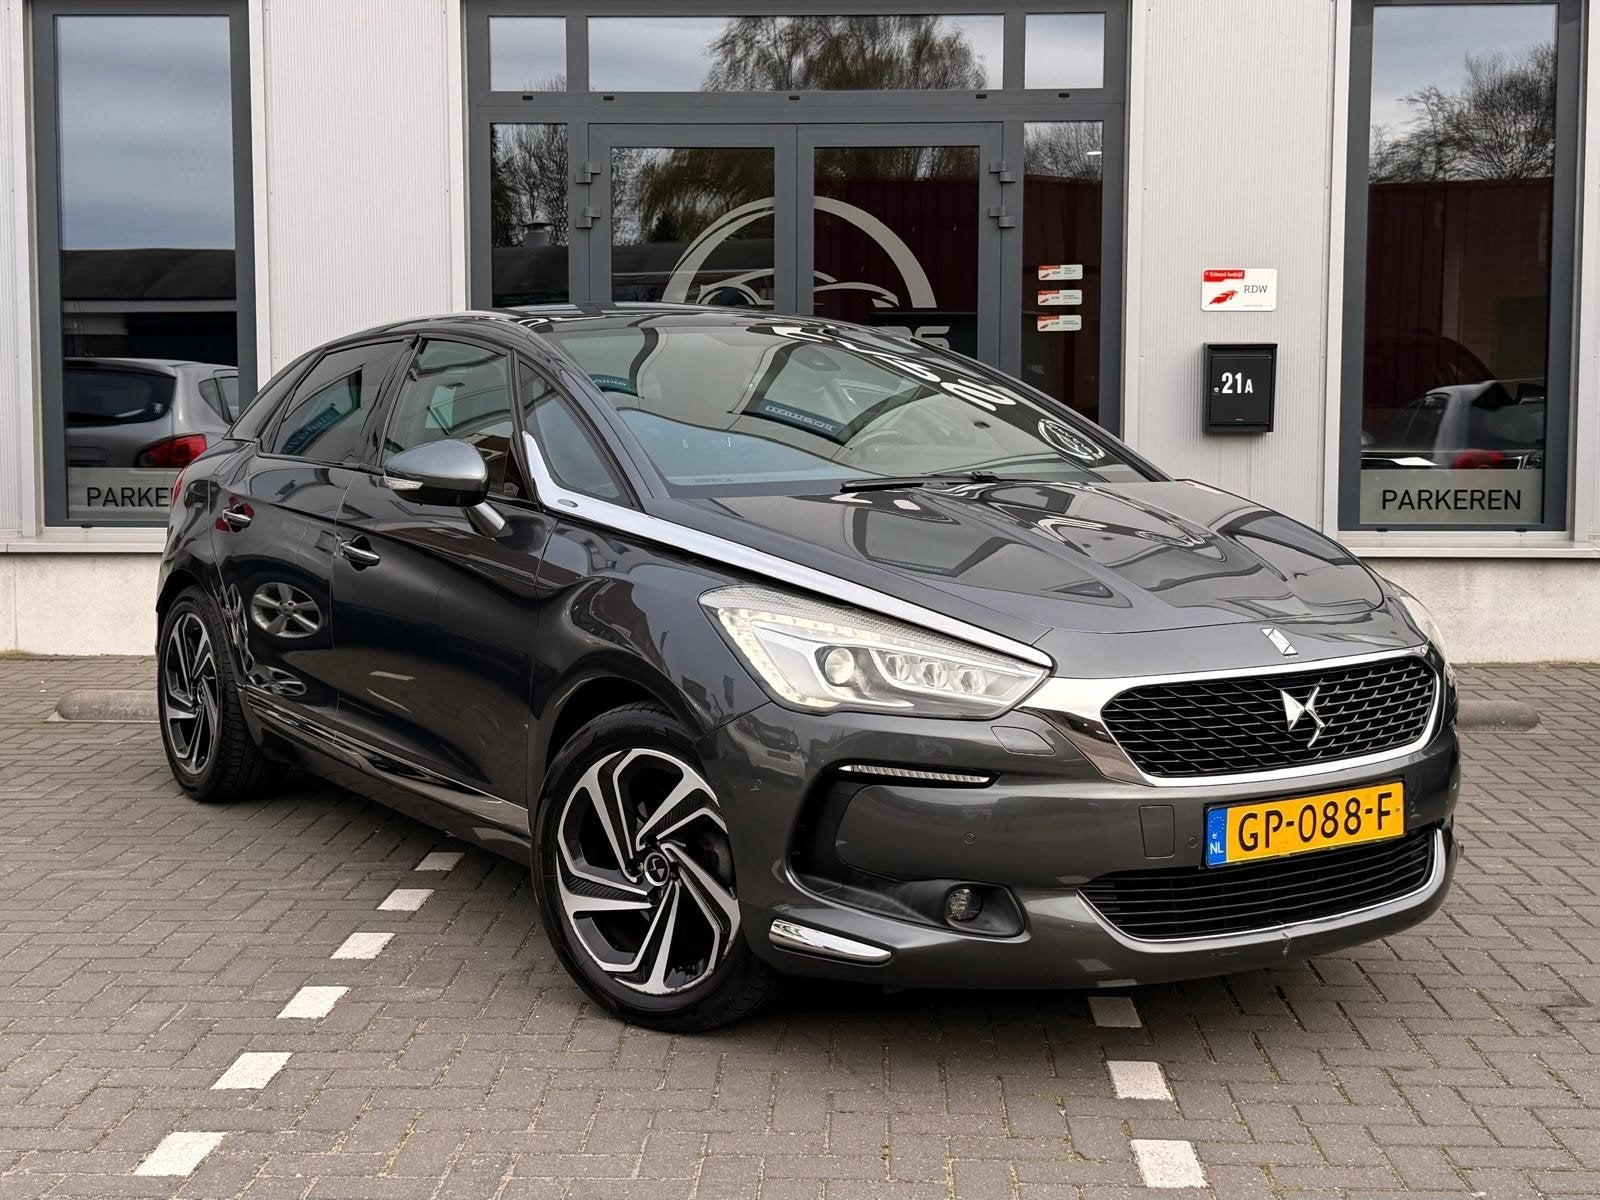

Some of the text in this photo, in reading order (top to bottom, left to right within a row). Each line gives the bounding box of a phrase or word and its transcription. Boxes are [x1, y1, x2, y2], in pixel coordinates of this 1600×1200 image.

[1243, 284, 1268, 294] RDW
[1221, 372, 1254, 394] 21A
[86, 486, 174, 507] PARKE
[1381, 489, 1522, 510] PARKEREN
[1238, 791, 1393, 852] GP-088-F
[1209, 841, 1225, 855] NL
